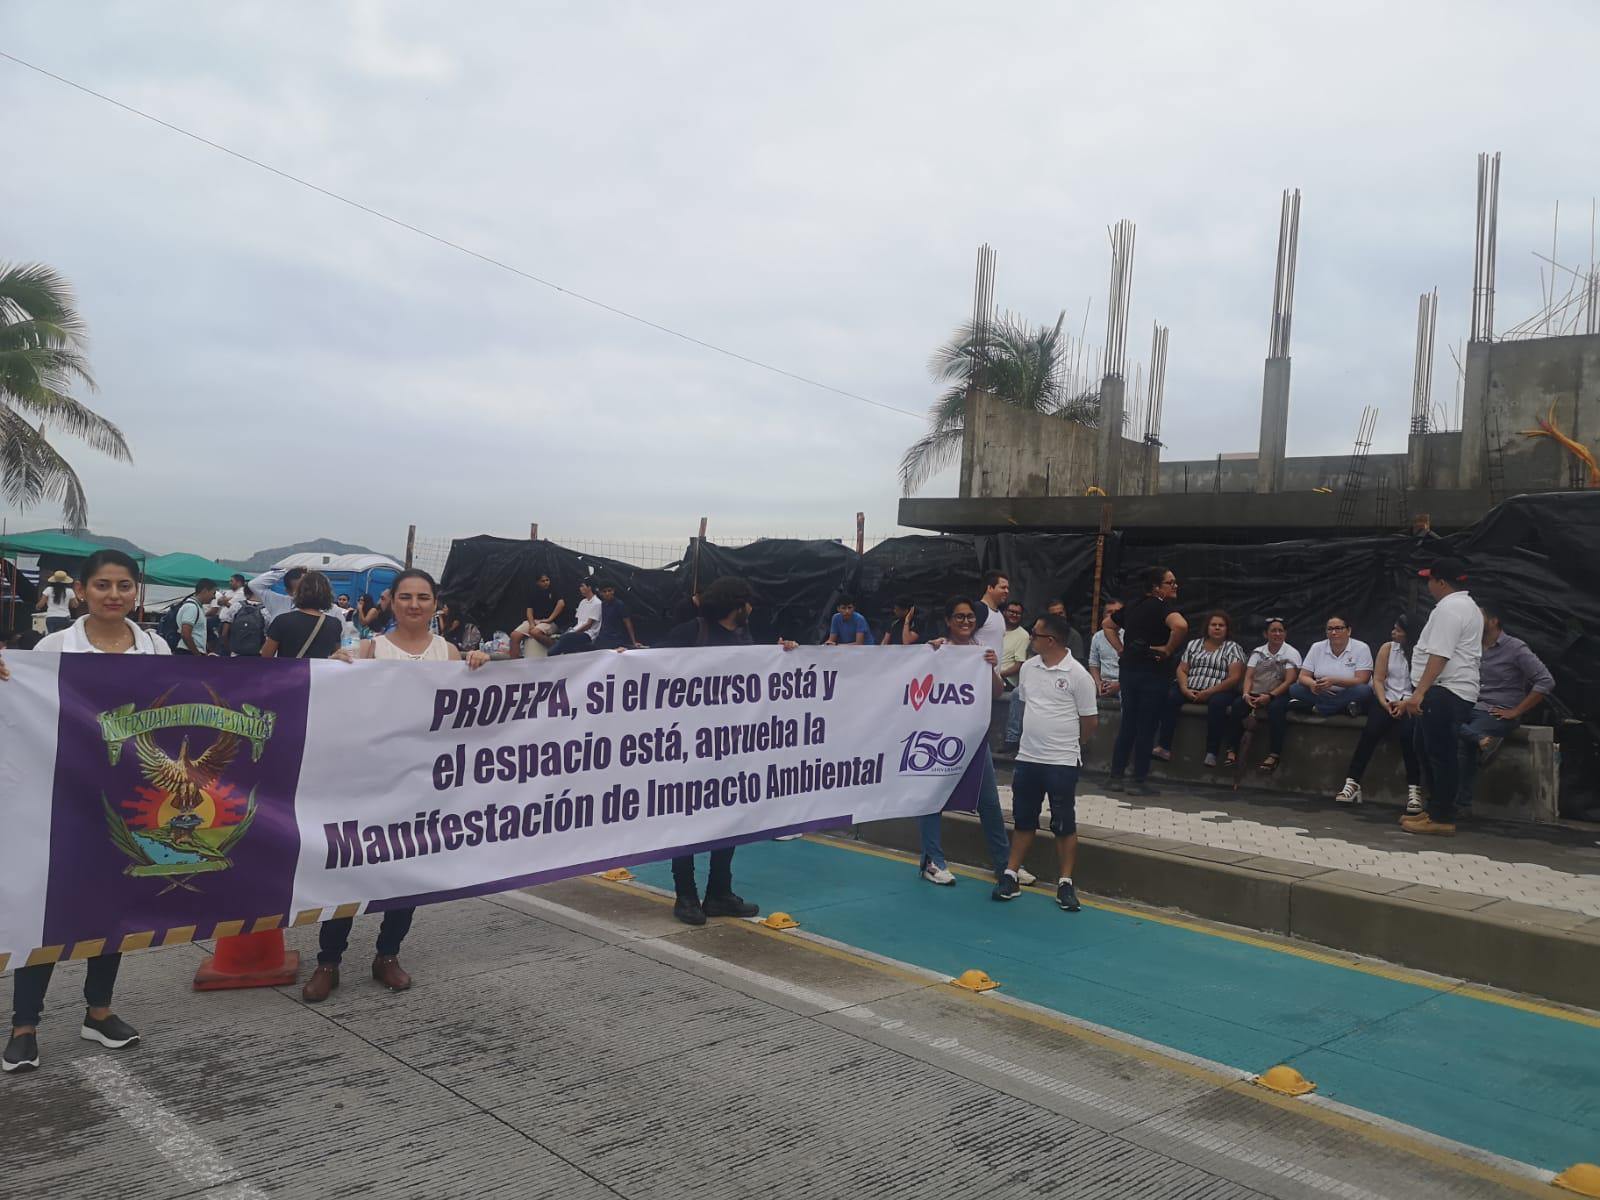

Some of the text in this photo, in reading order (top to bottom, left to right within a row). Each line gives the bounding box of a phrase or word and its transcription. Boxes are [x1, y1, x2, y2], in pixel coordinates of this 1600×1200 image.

[429, 664, 839, 733] PROFEPA, si el recurso está y
[432, 711, 826, 791] el espacio está, aprueba la
[899, 730, 966, 772] 150
[323, 752, 885, 870] Manifestación de Impacto Ambiental
